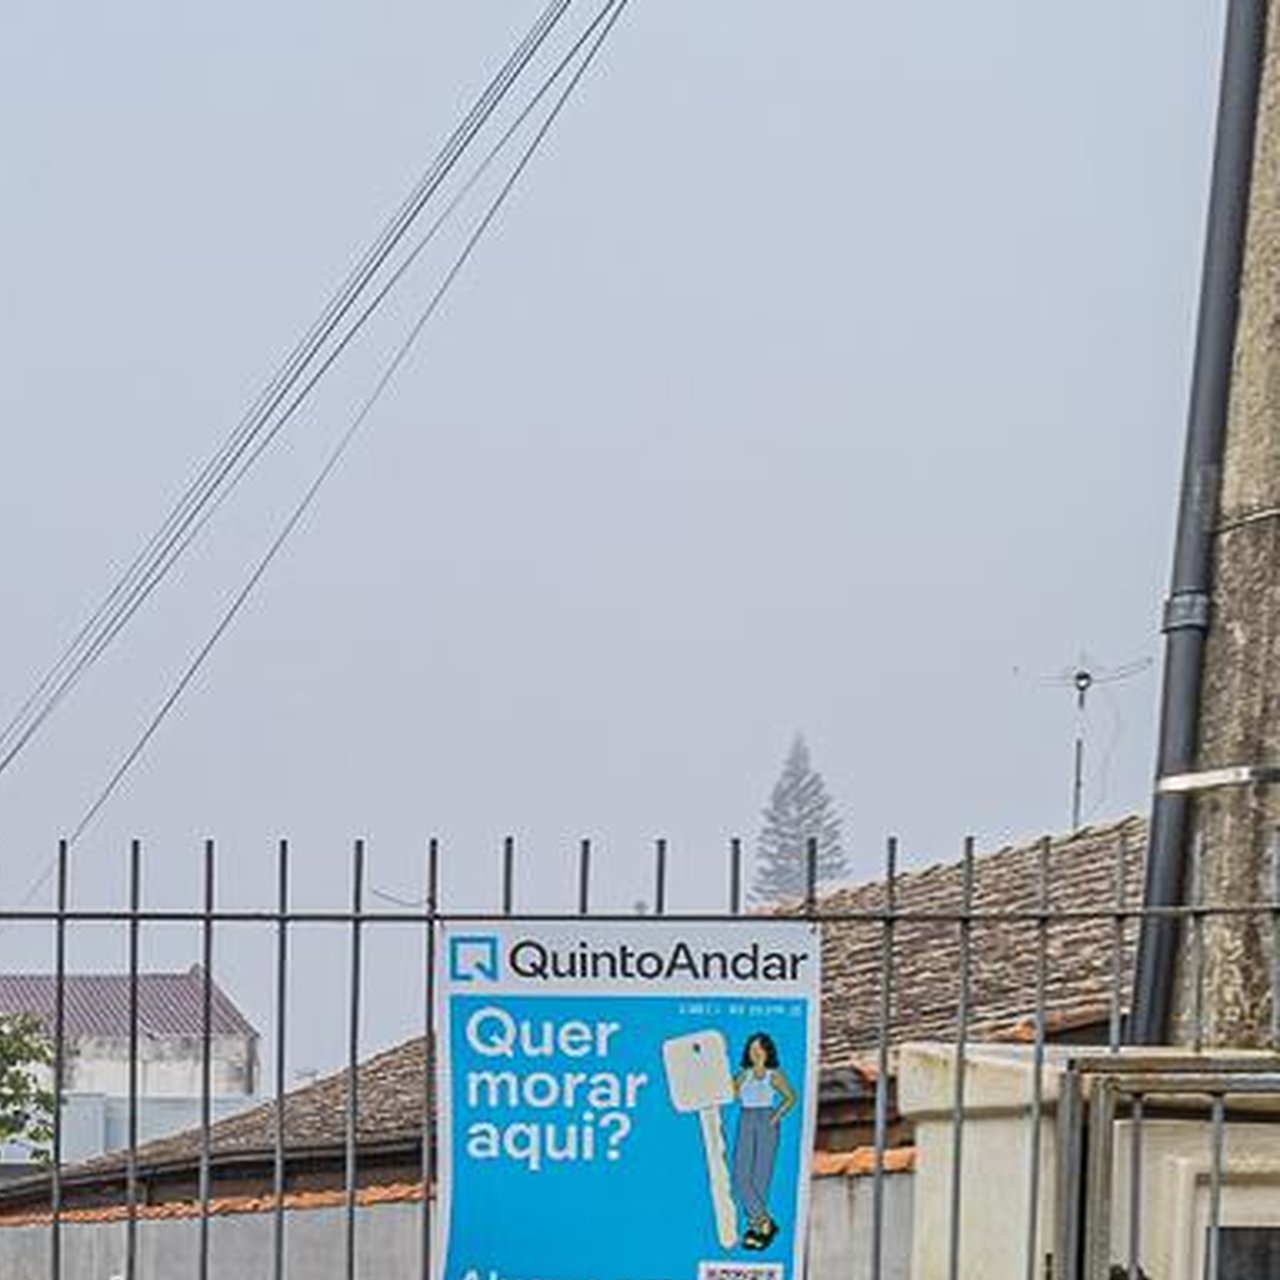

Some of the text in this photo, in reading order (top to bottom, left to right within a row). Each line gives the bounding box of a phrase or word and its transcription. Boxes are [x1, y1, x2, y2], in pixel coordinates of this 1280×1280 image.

[509, 941, 809, 981] QuintoAndar
[466, 1006, 620, 1057] Quer
[467, 1071, 648, 1109] morar
[467, 1112, 631, 1171] aqui?
